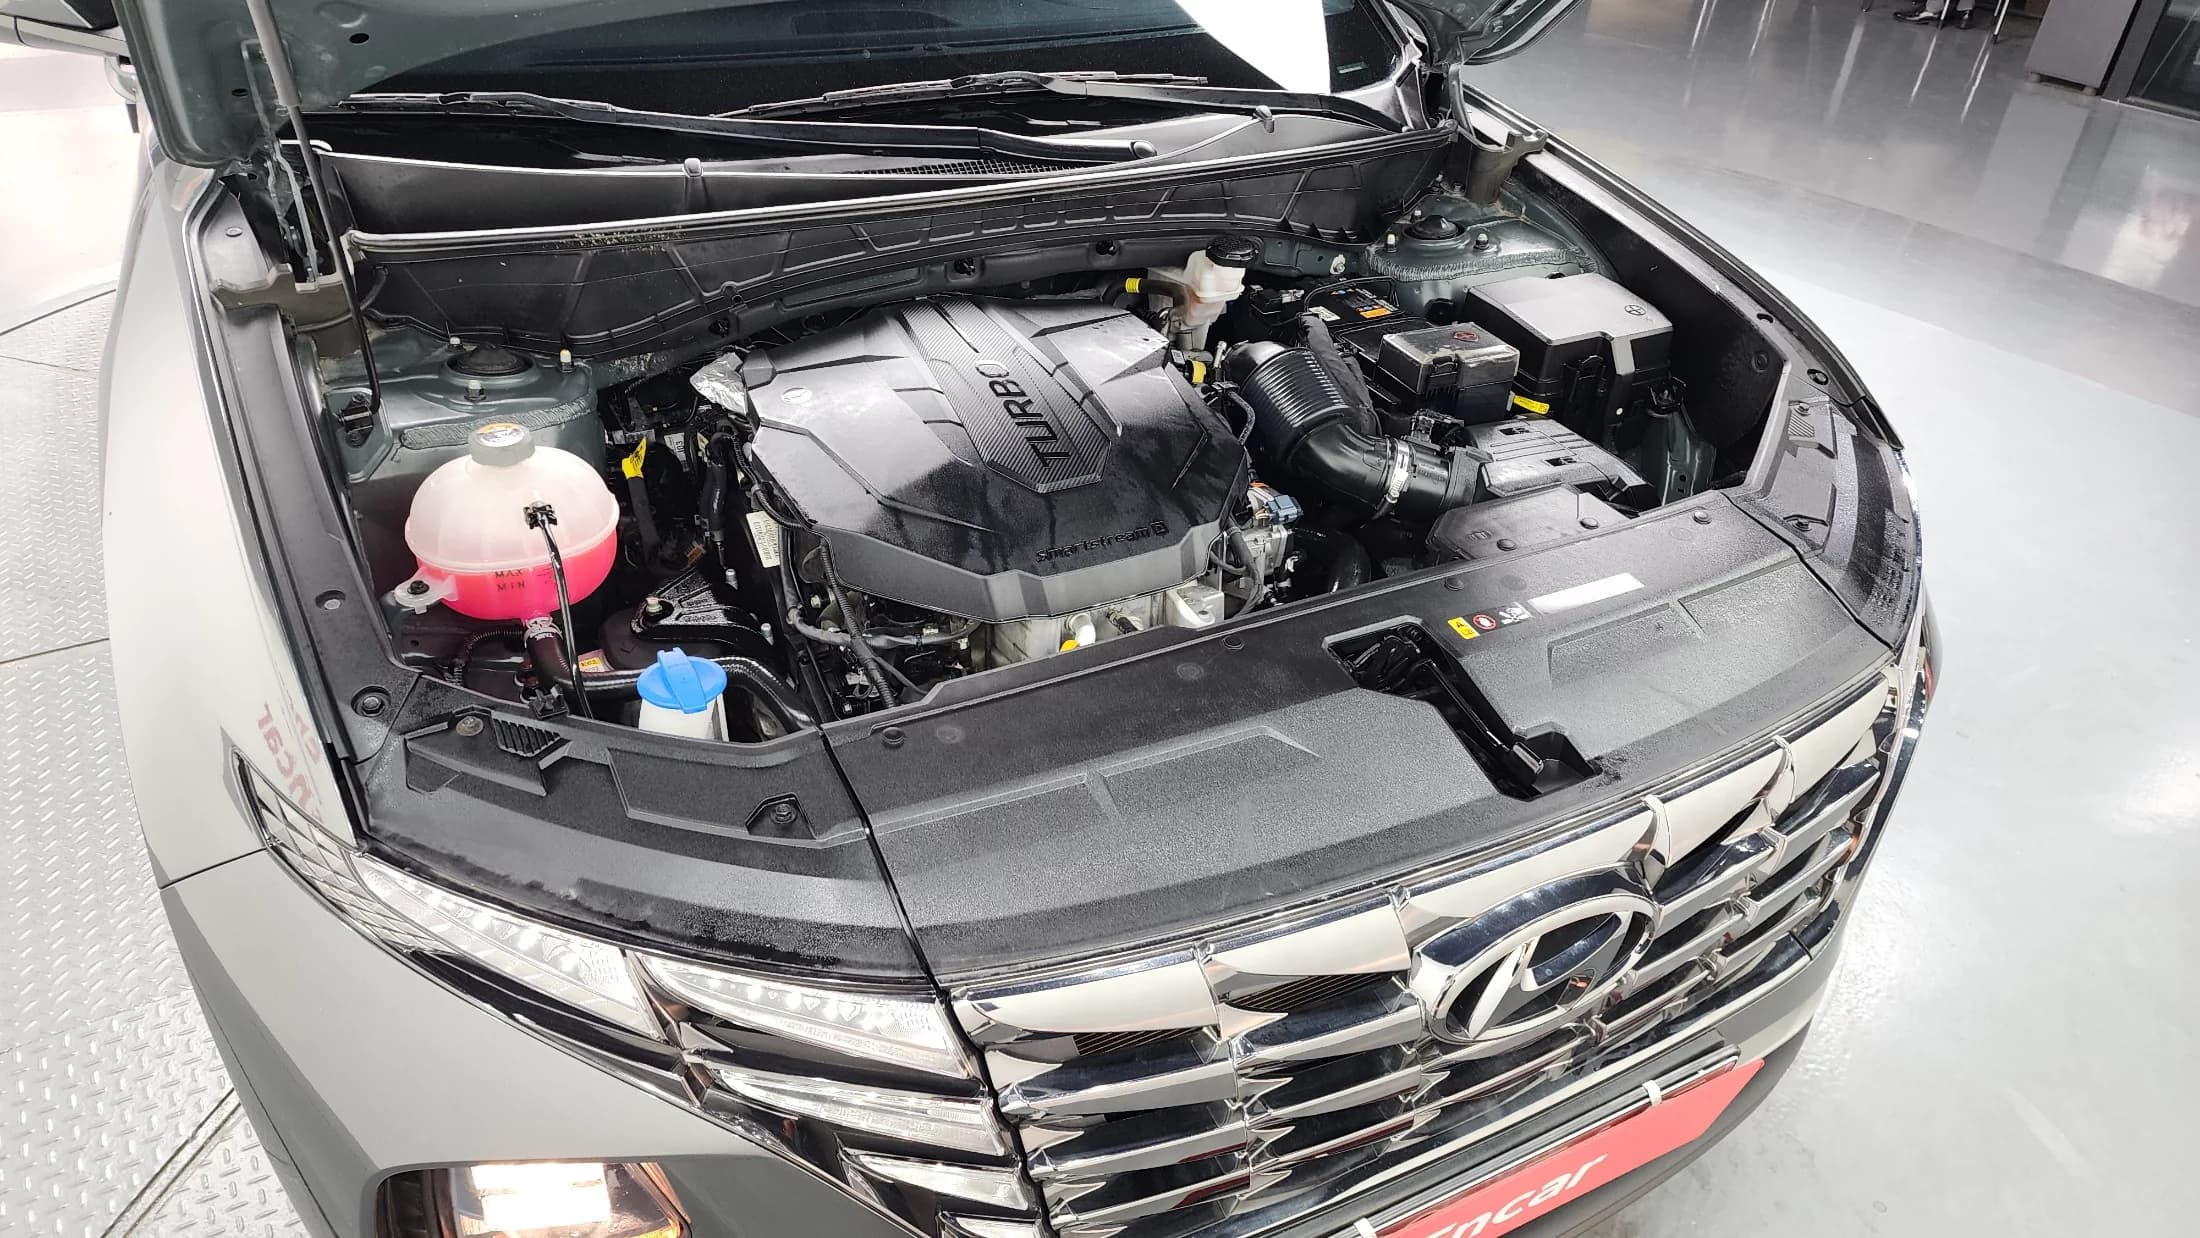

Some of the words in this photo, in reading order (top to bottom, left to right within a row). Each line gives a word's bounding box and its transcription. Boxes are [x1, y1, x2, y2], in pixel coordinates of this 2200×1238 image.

[975, 361, 1071, 469] TURBO
[495, 569, 522, 579] MAX
[497, 581, 525, 592] MIN
